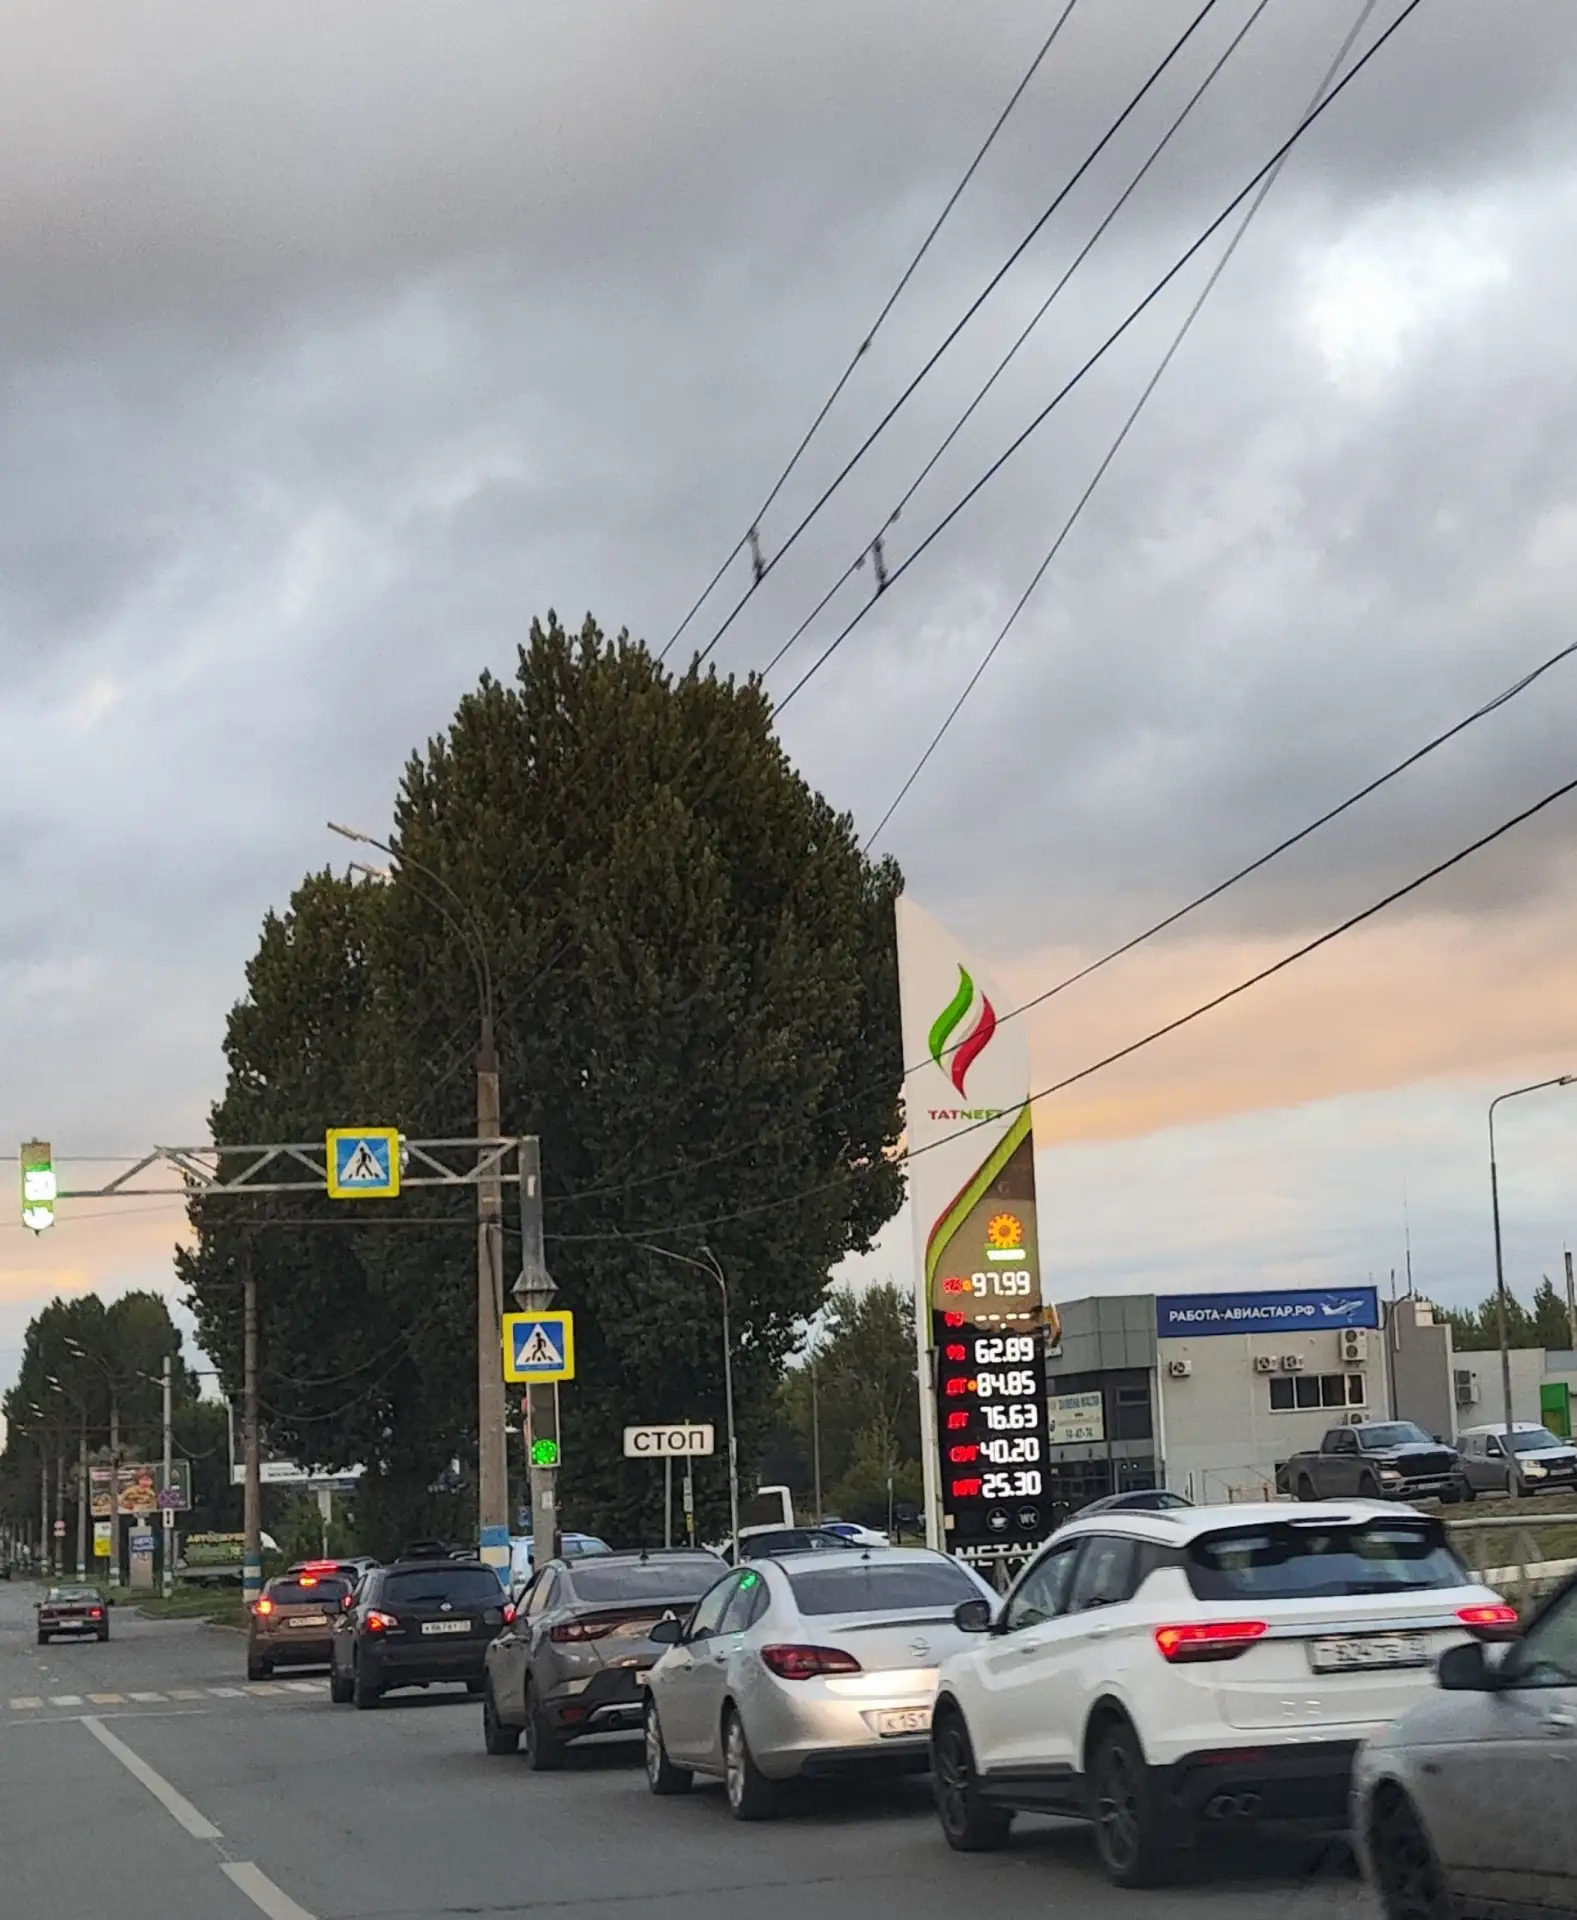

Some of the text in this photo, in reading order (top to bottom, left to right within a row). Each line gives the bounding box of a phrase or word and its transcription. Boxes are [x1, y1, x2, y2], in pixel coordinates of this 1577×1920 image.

[973, 1272, 1029, 1296] 97.99
[1169, 1306, 1315, 1322] РАБОТА-АВИАСТАР.РФ
[975, 1338, 1033, 1363] 62.89
[977, 1371, 1035, 1396] 84.85
[981, 1404, 1037, 1429] 76.63
[633, 1431, 704, 1451] СТОП
[981, 1438, 1039, 1463] 40.20
[983, 1471, 1041, 1498] 25.30
[1020, 1513, 1036, 1524] WC
